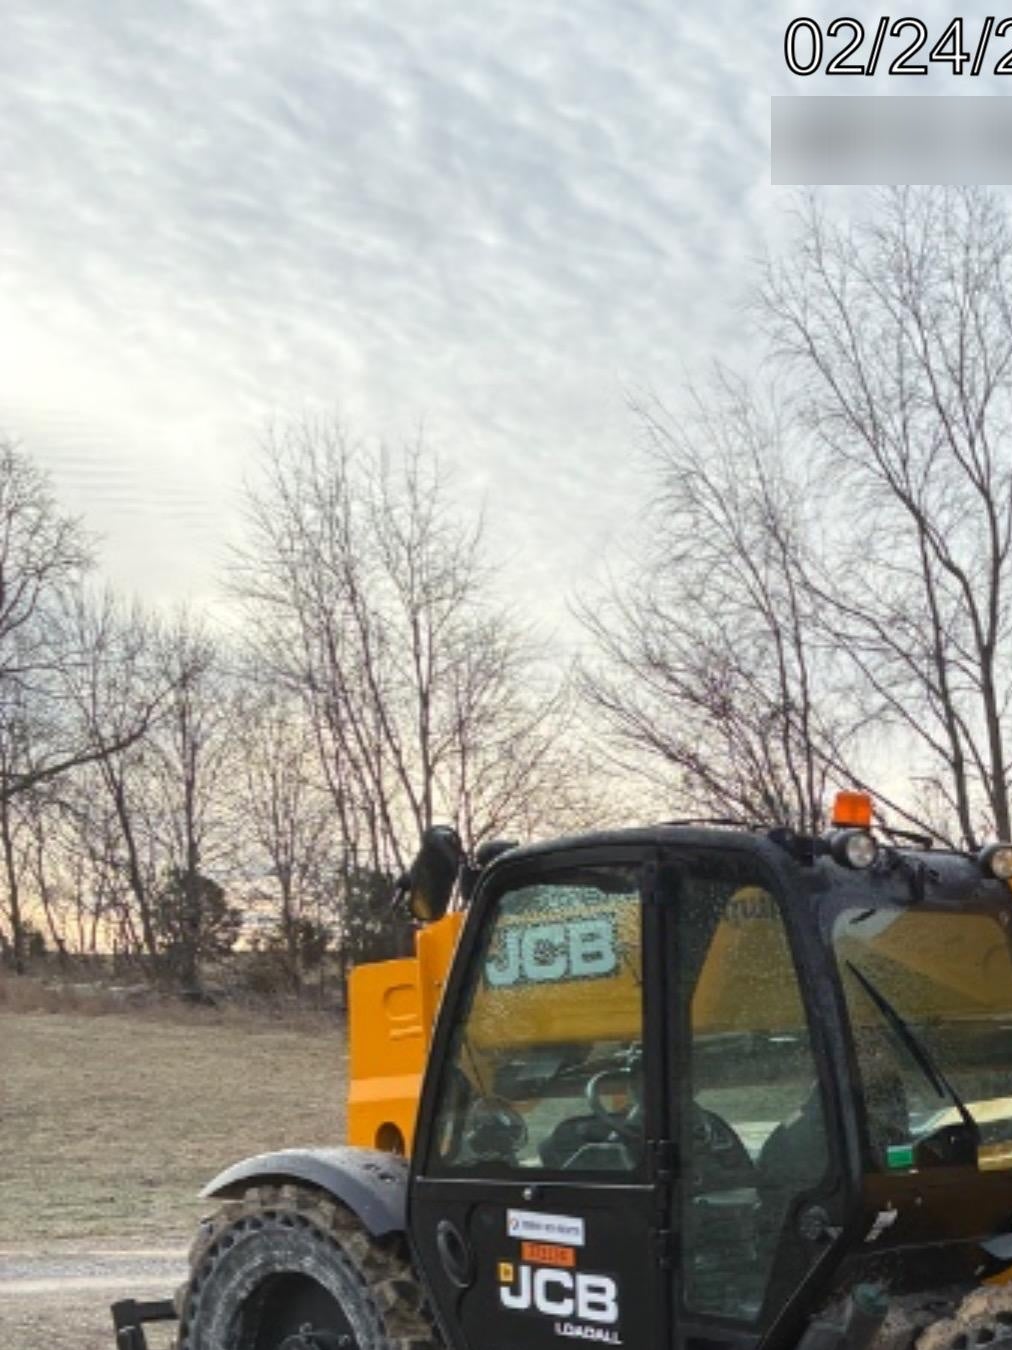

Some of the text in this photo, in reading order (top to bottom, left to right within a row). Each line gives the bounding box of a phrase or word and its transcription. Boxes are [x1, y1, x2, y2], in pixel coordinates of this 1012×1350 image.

[485, 919, 616, 986] JCB
[499, 1264, 619, 1324] JCB
[553, 1320, 624, 1345] LOADALL
